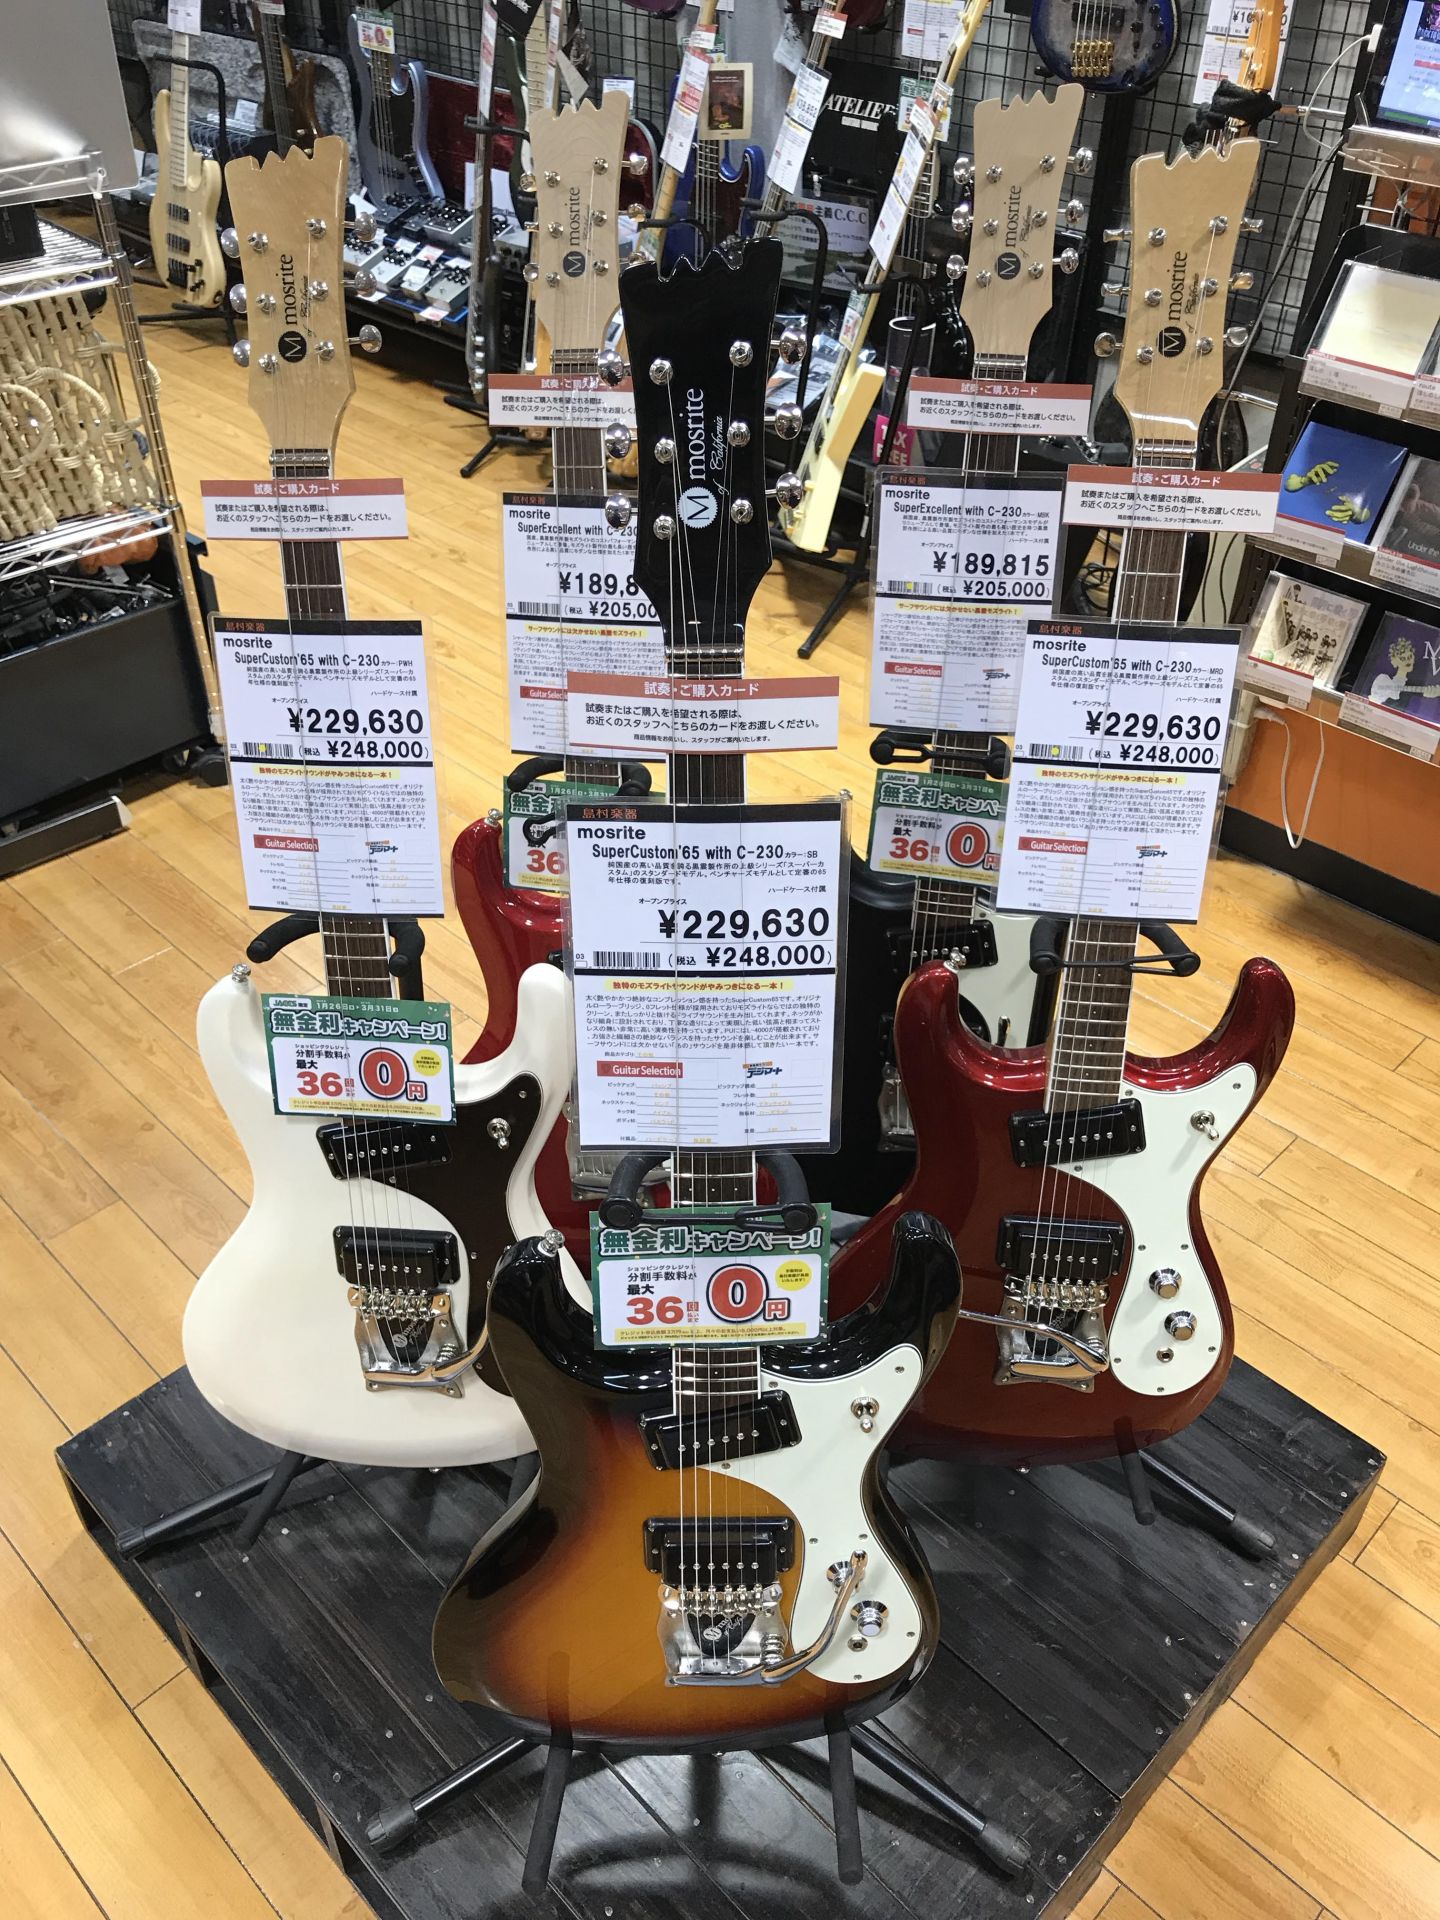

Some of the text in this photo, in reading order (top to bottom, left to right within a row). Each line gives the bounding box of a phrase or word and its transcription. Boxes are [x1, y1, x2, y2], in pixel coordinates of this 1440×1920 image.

[564, 187, 580, 246] mosrite
[1003, 185, 1021, 248] mosrite
[275, 254, 298, 325] mosrite
[1166, 251, 1188, 321] mosrite
[679, 388, 706, 480] mosrite
[880, 424, 907, 449] TX
[710, 416, 727, 470] California
[876, 443, 907, 467] FEE
[885, 489, 930, 500] mosrite
[509, 509, 551, 520] mosrite
[893, 502, 1022, 518] SuperExcellent with C-230
[517, 522, 581, 535] SuperExcellent
[585, 526, 603, 535] with
[933, 551, 1049, 577] ¥189,815
[223, 636, 273, 649] mosrite
[1033, 639, 1087, 652] mosrite
[318, 654, 339, 666] with
[343, 655, 380, 667] C-230
[1131, 660, 1151, 672] with
[1155, 661, 1192, 673] C-230
[644, 681, 759, 698] 試奏・ご購入カード
[287, 707, 423, 736] ¥229,630
[1086, 710, 1221, 741] ¥229,630
[577, 825, 646, 840] mosrite
[265, 839, 318, 851] Guitar Selection
[592, 844, 700, 860] SuperCustom'65
[705, 844, 731, 860] with
[736, 844, 784, 860] C-230
[889, 838, 929, 861] 36
[1030, 840, 1087, 854] Guitar Selection
[658, 907, 830, 941] ¥229,630
[296, 1060, 318, 1069] 最大
[612, 1065, 681, 1076] Guitar Selection
[297, 1071, 343, 1097] 36
[361, 1048, 408, 1099] 0
[406, 1082, 426, 1100] 円
[626, 1296, 684, 1325] 36
[707, 1263, 768, 1324] 0
[764, 1298, 790, 1321] 円
[627, 1284, 655, 1295] 最大
